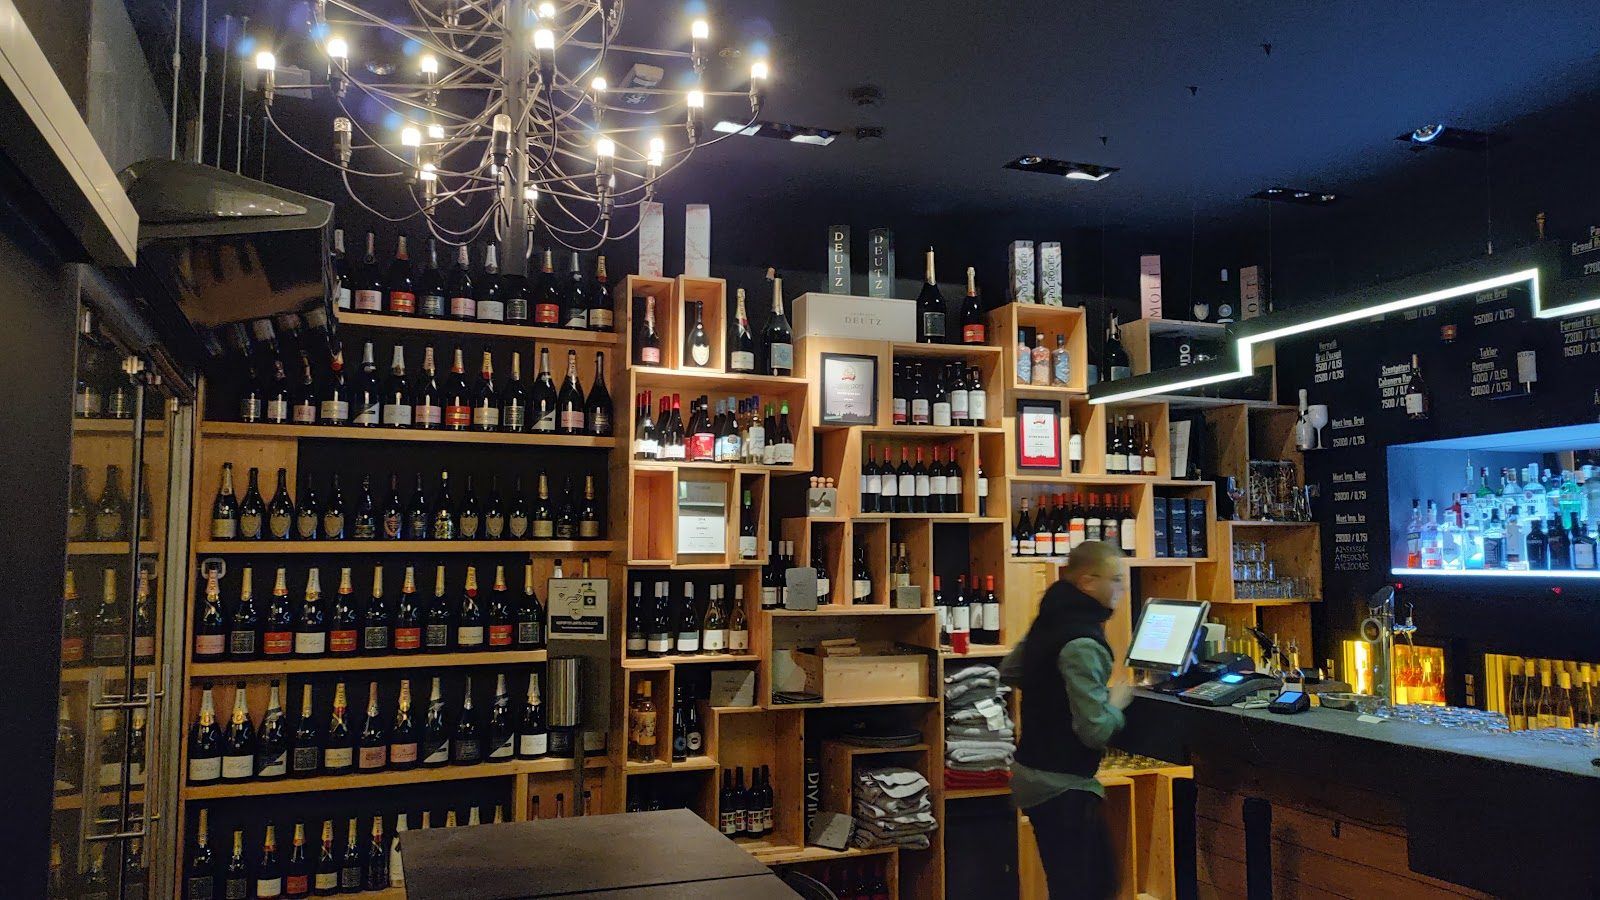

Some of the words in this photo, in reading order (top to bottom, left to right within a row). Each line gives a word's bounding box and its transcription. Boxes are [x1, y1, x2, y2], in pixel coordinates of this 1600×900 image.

[834, 231, 844, 287] DEUTZ
[874, 235, 883, 290] DEUTZ
[1020, 253, 1028, 281] ROGER
[1047, 254, 1056, 282] ROGER
[1020, 281, 1028, 298] POL
[1047, 282, 1056, 299] POL
